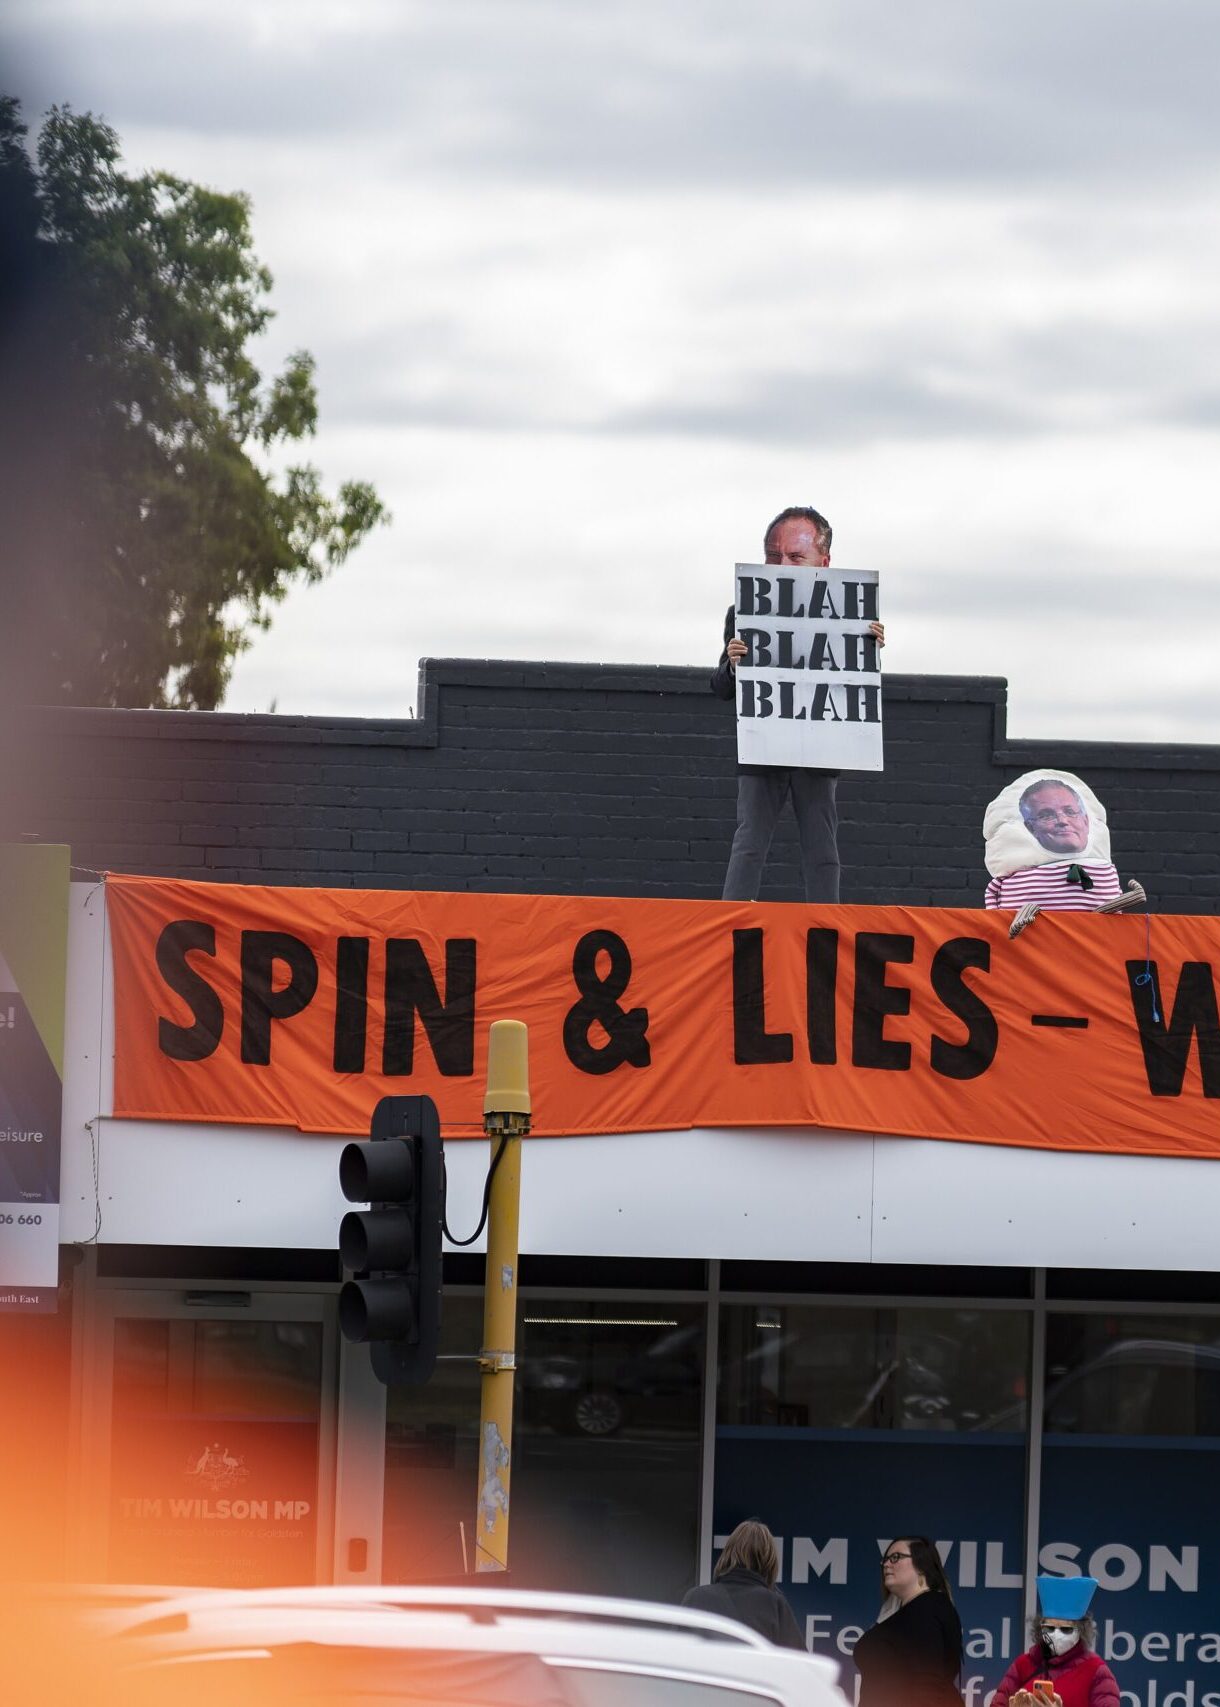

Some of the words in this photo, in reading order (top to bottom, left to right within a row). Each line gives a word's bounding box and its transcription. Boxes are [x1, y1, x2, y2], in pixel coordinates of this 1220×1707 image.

[737, 576, 880, 621] BLAH
[737, 628, 881, 673] BLAH
[739, 680, 881, 723] BLAH
[155, 919, 477, 1077] SPIN
[562, 929, 652, 1076] &
[732, 927, 999, 1081] LIES
[18, 1214, 42, 1226] 660
[19, 1293, 39, 1304] East
[120, 1498, 162, 1519] TIM
[168, 1499, 268, 1520] WILSON
[274, 1500, 311, 1521] MP
[805, 1614, 1011, 1659] Feal
